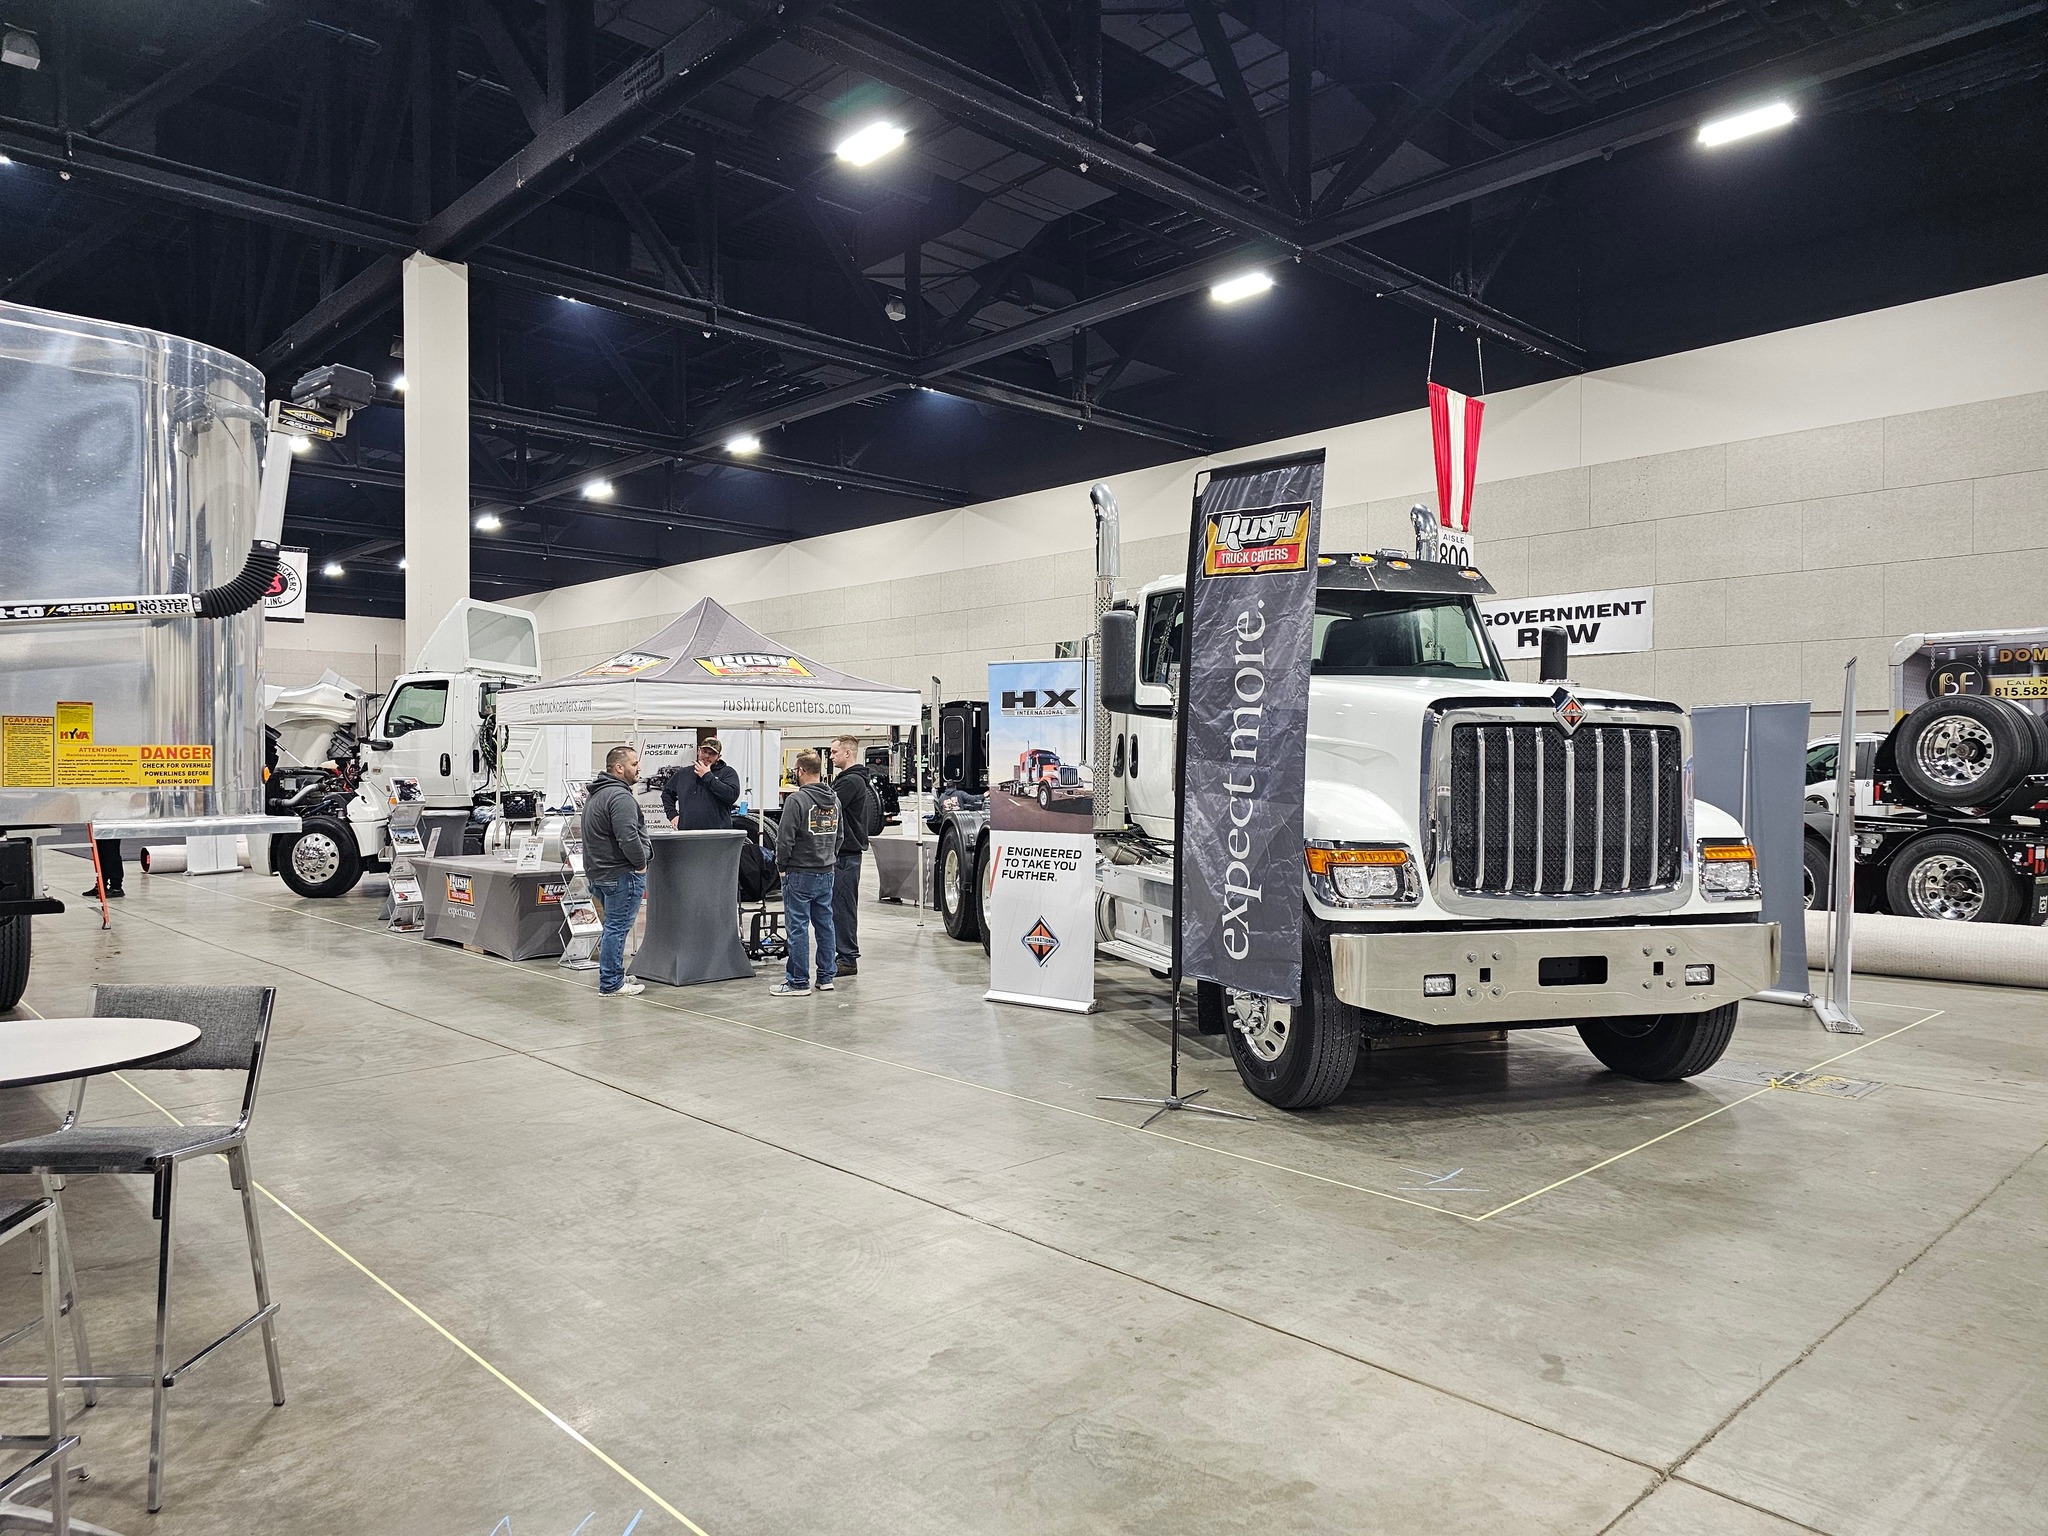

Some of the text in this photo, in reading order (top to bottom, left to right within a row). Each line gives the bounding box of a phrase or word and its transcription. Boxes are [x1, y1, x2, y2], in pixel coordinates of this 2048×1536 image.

[1216, 511, 1301, 551] RUSH
[1442, 535, 1466, 545] AISLE
[1221, 548, 1289, 564] TRUCK CENTERS
[1439, 542, 1469, 566] 800
[276, 564, 297, 592] UCKERS
[56, 602, 135, 613] 4500HD
[140, 602, 188, 611] NO STEP
[1481, 600, 1647, 627] GOVERNMENT
[1517, 622, 1601, 648] RW
[709, 654, 790, 668] RUSH
[1001, 688, 1079, 709] HX
[1994, 687, 2048, 697] 815.582
[723, 697, 852, 715] rushtruckcenters.com
[60, 728, 90, 739] HYVA
[141, 747, 212, 760] DANGER
[1221, 598, 1266, 961] expect more.
[1007, 846, 1082, 860] ENGINEERED
[1004, 858, 1077, 871] TO TAKE YOU
[449, 875, 469, 891] RUSH
[544, 884, 568, 896] RUS
[448, 906, 462, 918] expect
